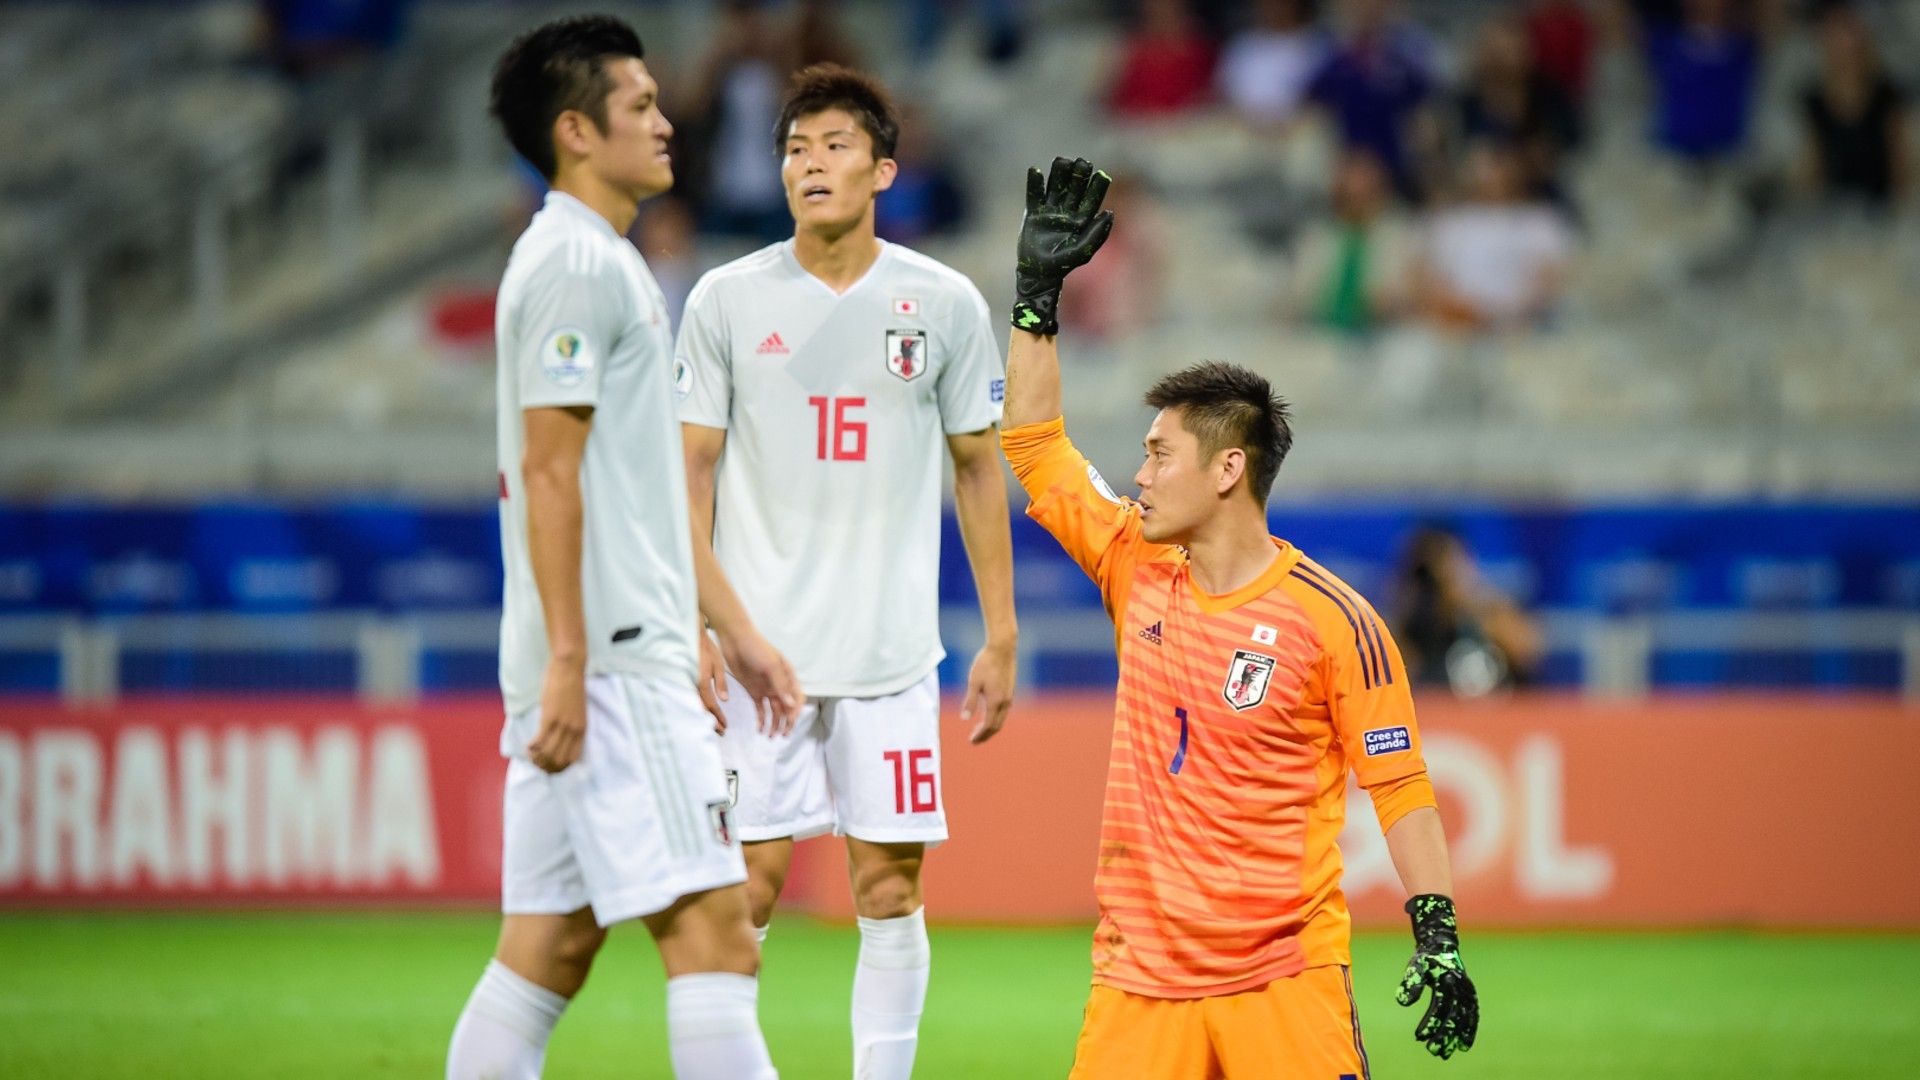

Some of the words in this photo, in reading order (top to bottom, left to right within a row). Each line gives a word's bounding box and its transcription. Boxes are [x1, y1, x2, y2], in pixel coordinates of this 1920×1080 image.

[808, 396, 867, 461] 16
[1366, 732, 1391, 743] Cree
[1392, 730, 1407, 738] en
[1368, 739, 1406, 755] grande
[883, 749, 937, 814] 16
